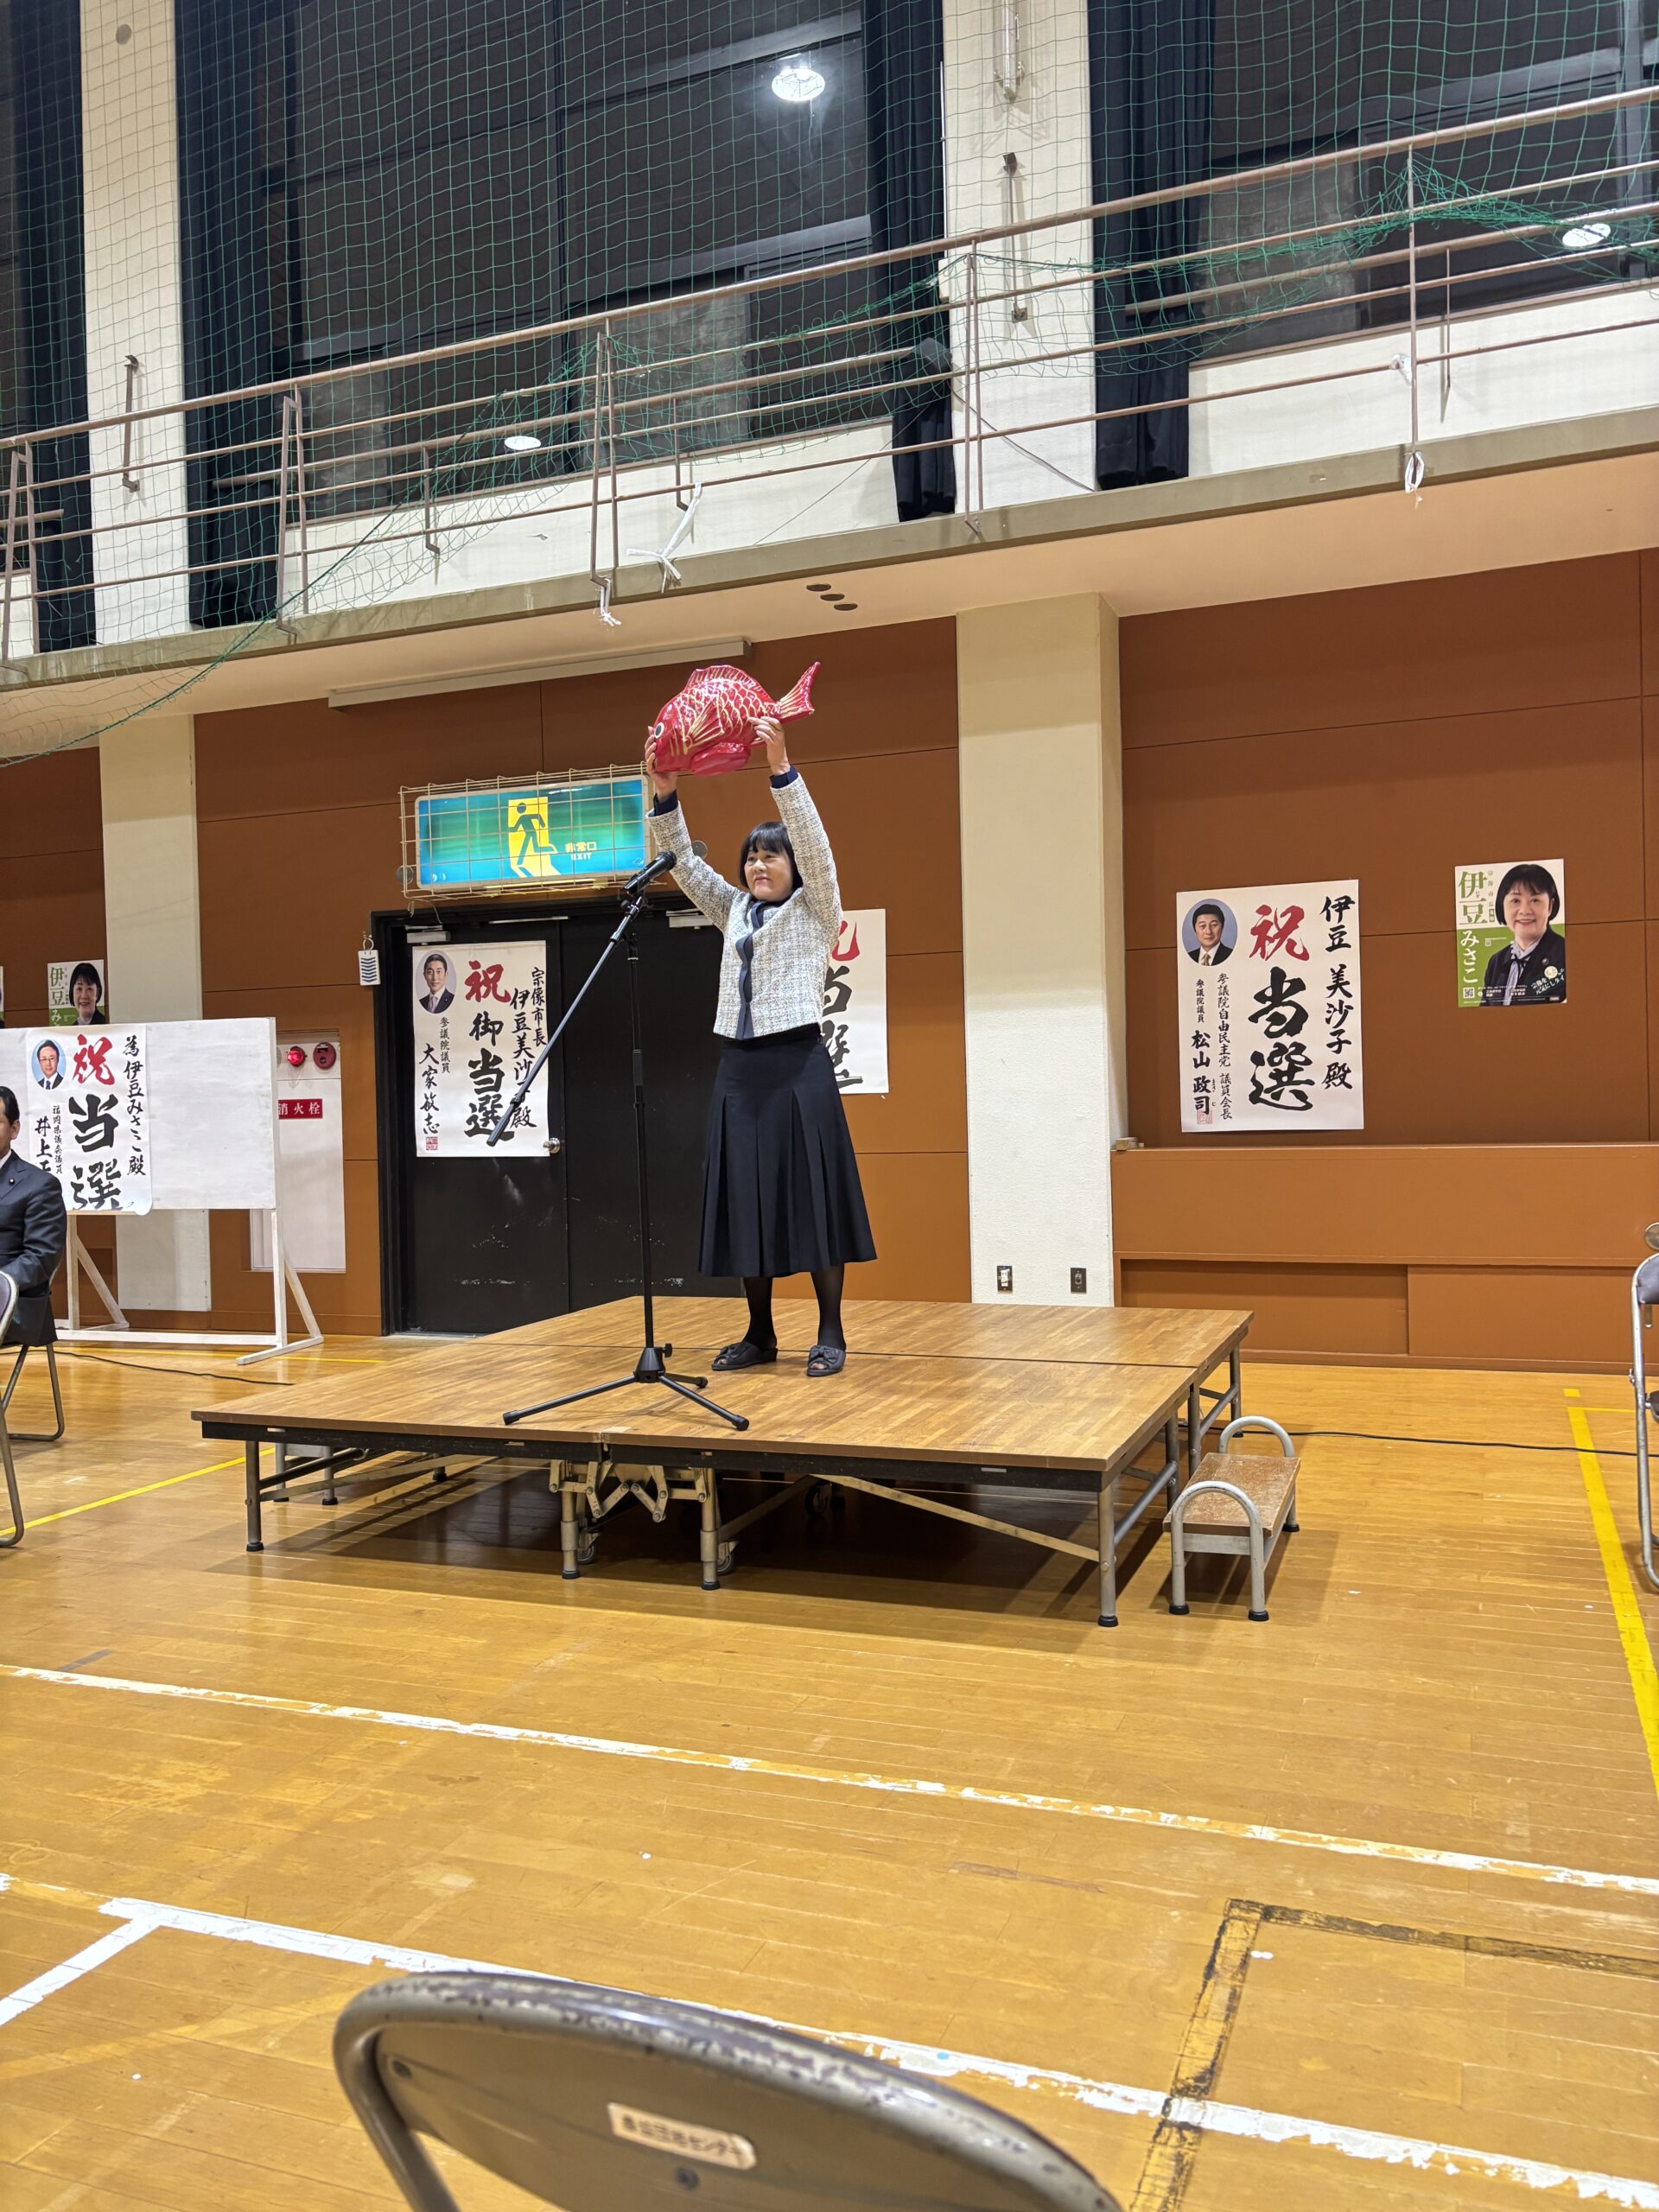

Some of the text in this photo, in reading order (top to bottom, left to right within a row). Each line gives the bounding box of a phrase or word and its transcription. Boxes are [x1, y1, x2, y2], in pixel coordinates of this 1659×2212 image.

[565, 842, 597, 853] 非常口
[571, 852, 592, 861] EXIT
[530, 966, 548, 1047] 宗像市長
[1196, 978, 1205, 1023] 参議院議員
[440, 1017, 450, 1073] 参議院議員
[419, 1043, 440, 1135] 大家敏志
[1192, 1030, 1211, 1115] 松山政司
[278, 1102, 321, 1115] 消火栓
